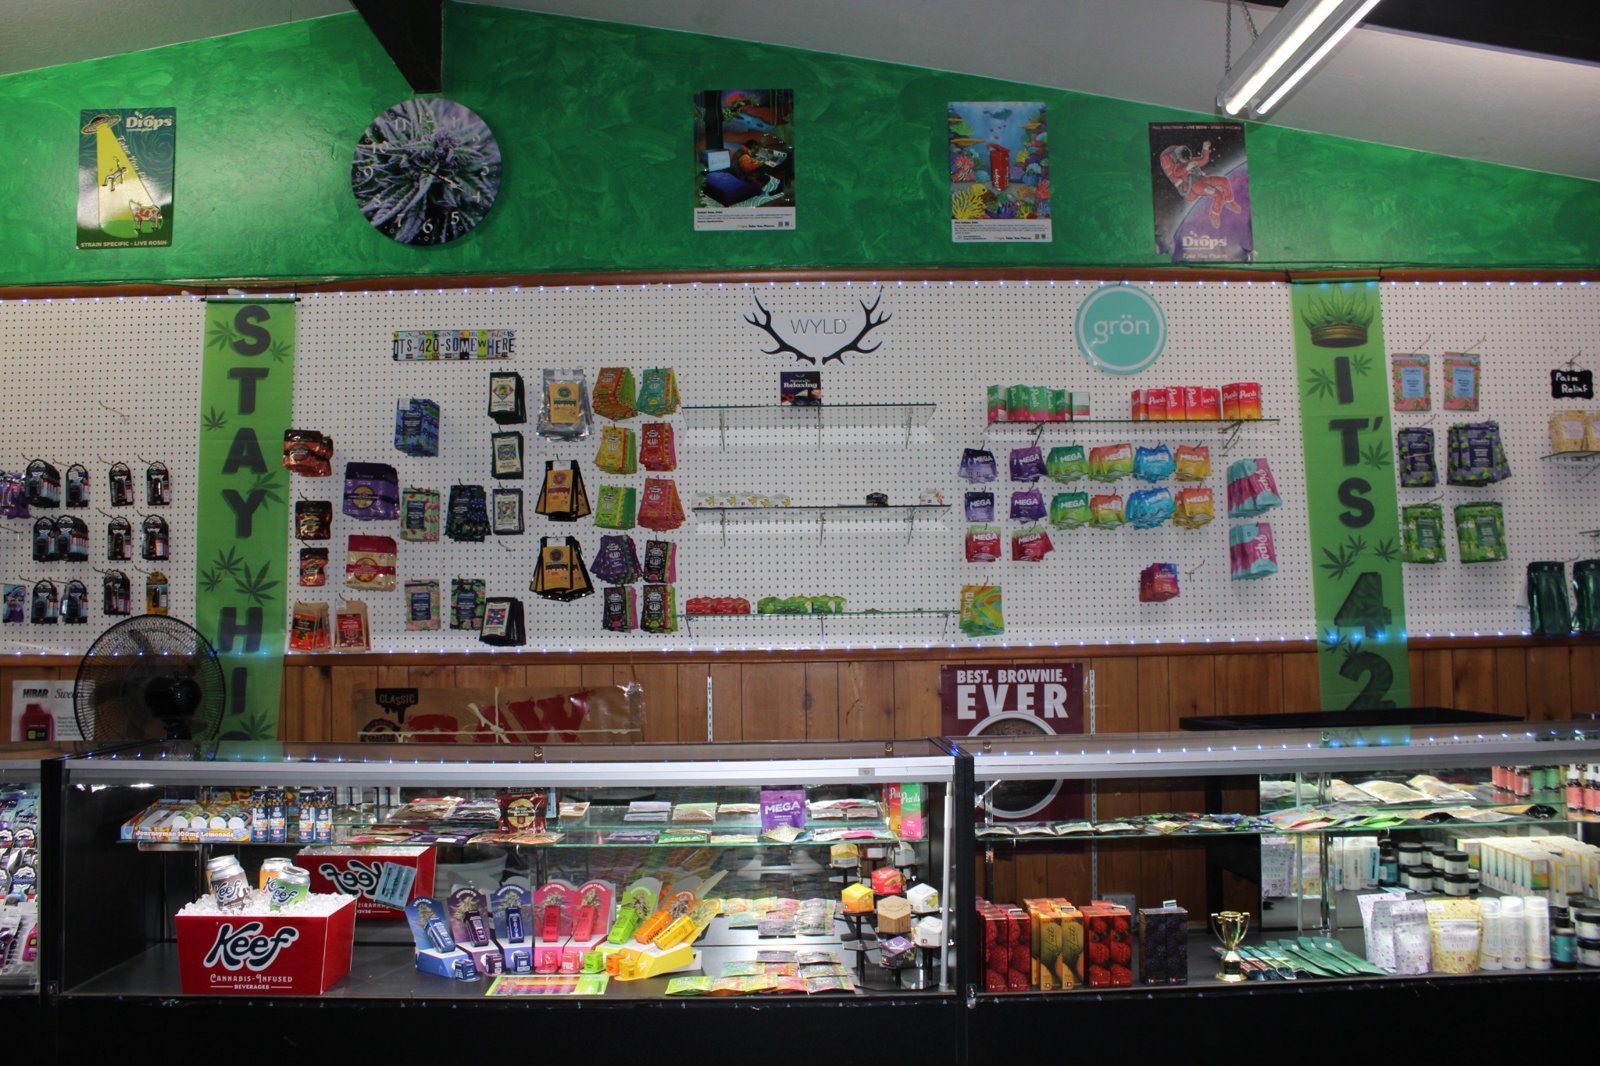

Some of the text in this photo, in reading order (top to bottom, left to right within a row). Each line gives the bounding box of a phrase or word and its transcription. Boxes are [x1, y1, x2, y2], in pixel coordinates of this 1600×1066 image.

[126, 115, 172, 131] Drops
[450, 211, 460, 225] 5
[422, 218, 434, 234] 6
[1182, 234, 1228, 250] Drops
[790, 318, 847, 335] WYLD
[1093, 313, 1151, 345] grön
[1555, 372, 1579, 383] Pain
[1328, 356, 1384, 529] IT'S
[1020, 454, 1040, 465] MEGA
[1060, 453, 1083, 463] MEGA
[970, 499, 992, 508] MEGA
[1014, 499, 1039, 507] MEGA
[1060, 500, 1086, 509] MEGA
[217, 304, 272, 740] STAY HI
[972, 532, 999, 542] MEGA
[1018, 533, 1041, 544] MEGA
[956, 668, 1068, 684] BEST. BROWNIE.
[956, 684, 1069, 719] EVER
[901, 792, 921, 805] Pearls
[764, 801, 801, 815] MEGA
[135, 831, 177, 839] Journeyman
[203, 922, 299, 971] Keef
